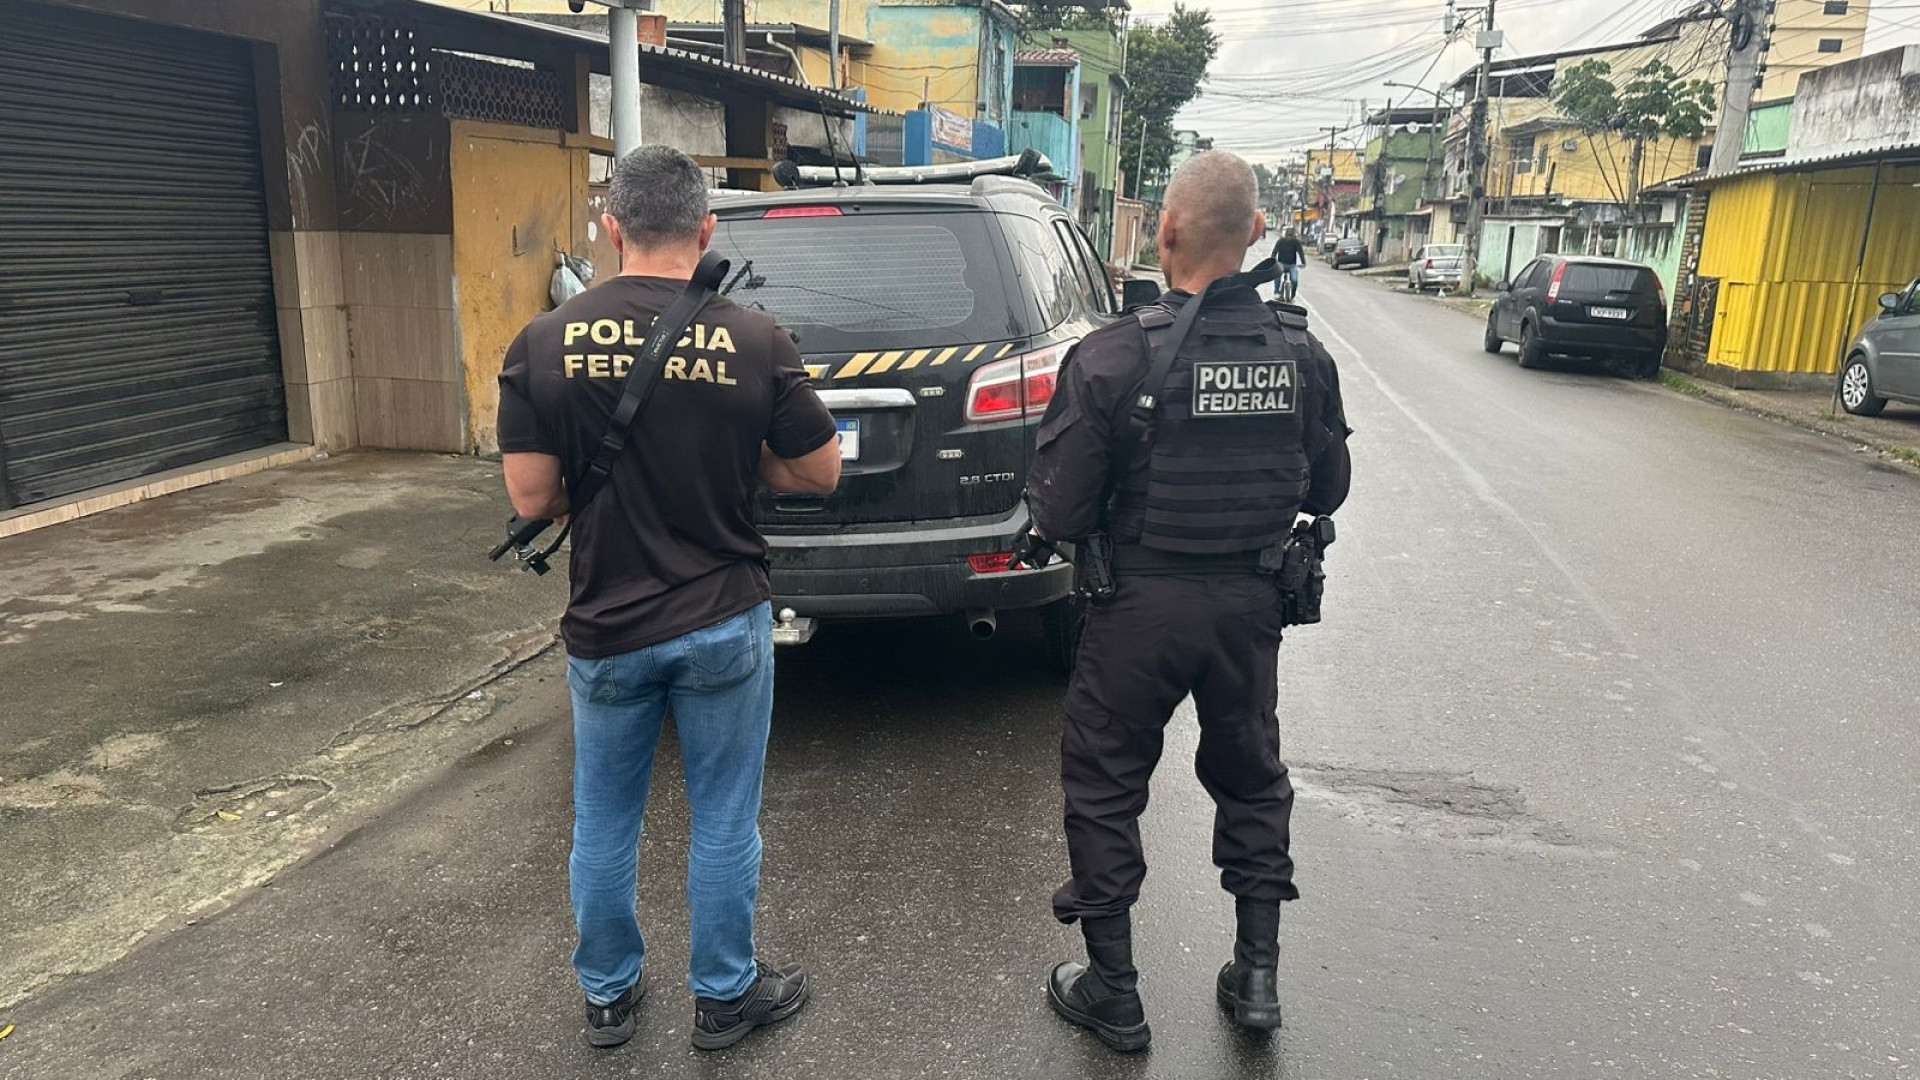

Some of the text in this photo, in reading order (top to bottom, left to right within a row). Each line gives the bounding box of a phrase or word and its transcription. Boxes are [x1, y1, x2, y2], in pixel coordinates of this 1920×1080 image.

[564, 354, 737, 385] FEDRAL
[1199, 391, 1289, 411] FEDERAL
[984, 472, 1015, 482] CTDI
